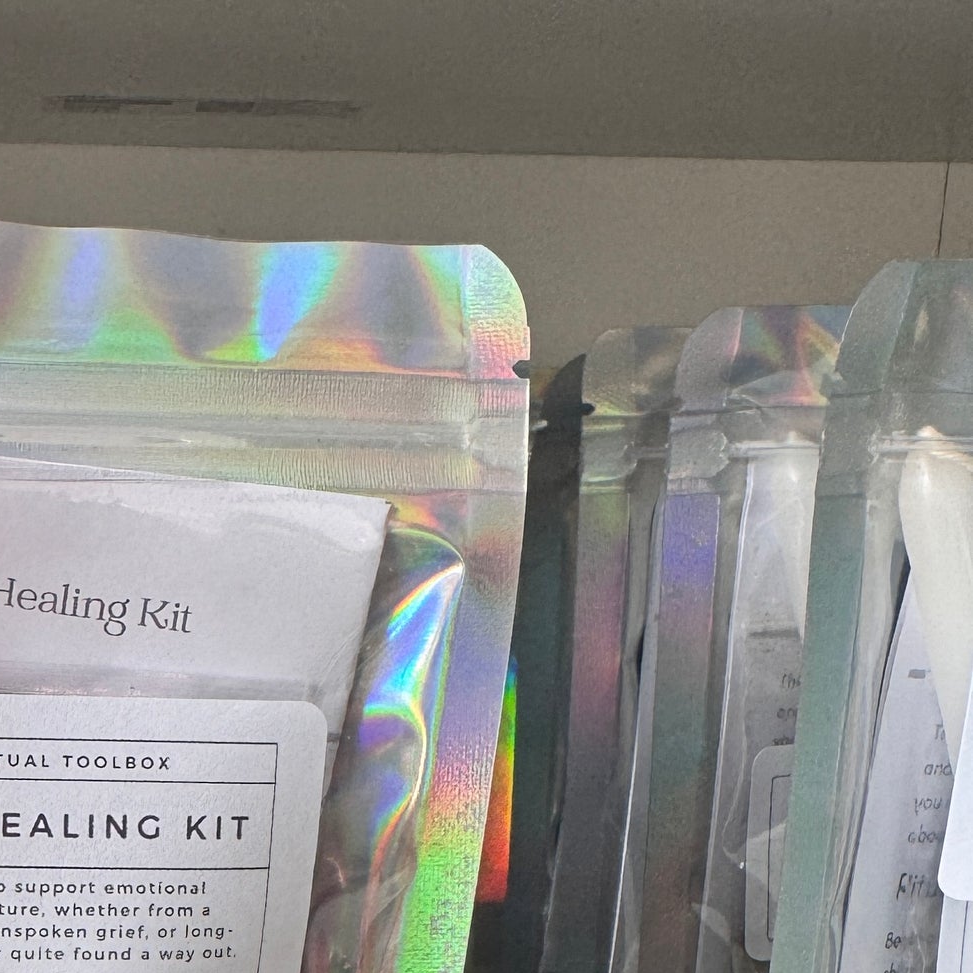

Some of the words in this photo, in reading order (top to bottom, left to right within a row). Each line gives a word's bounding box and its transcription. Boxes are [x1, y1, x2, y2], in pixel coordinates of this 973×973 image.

[137, 597, 193, 633] Kit
[62, 755, 170, 770] TOOLBOX
[186, 815, 249, 840] KIT
[14, 881, 96, 897] support
[103, 881, 207, 895] emotional
[54, 903, 140, 917] whether
[148, 903, 193, 917] from
[201, 906, 211, 917] a
[96, 925, 149, 941] grief,
[157, 927, 177, 939] or
[184, 924, 233, 940] long-
[10, 946, 64, 962] quite
[74, 946, 132, 961] found
[140, 950, 150, 961] a
[159, 948, 195, 963] way
[202, 945, 236, 959] out.
